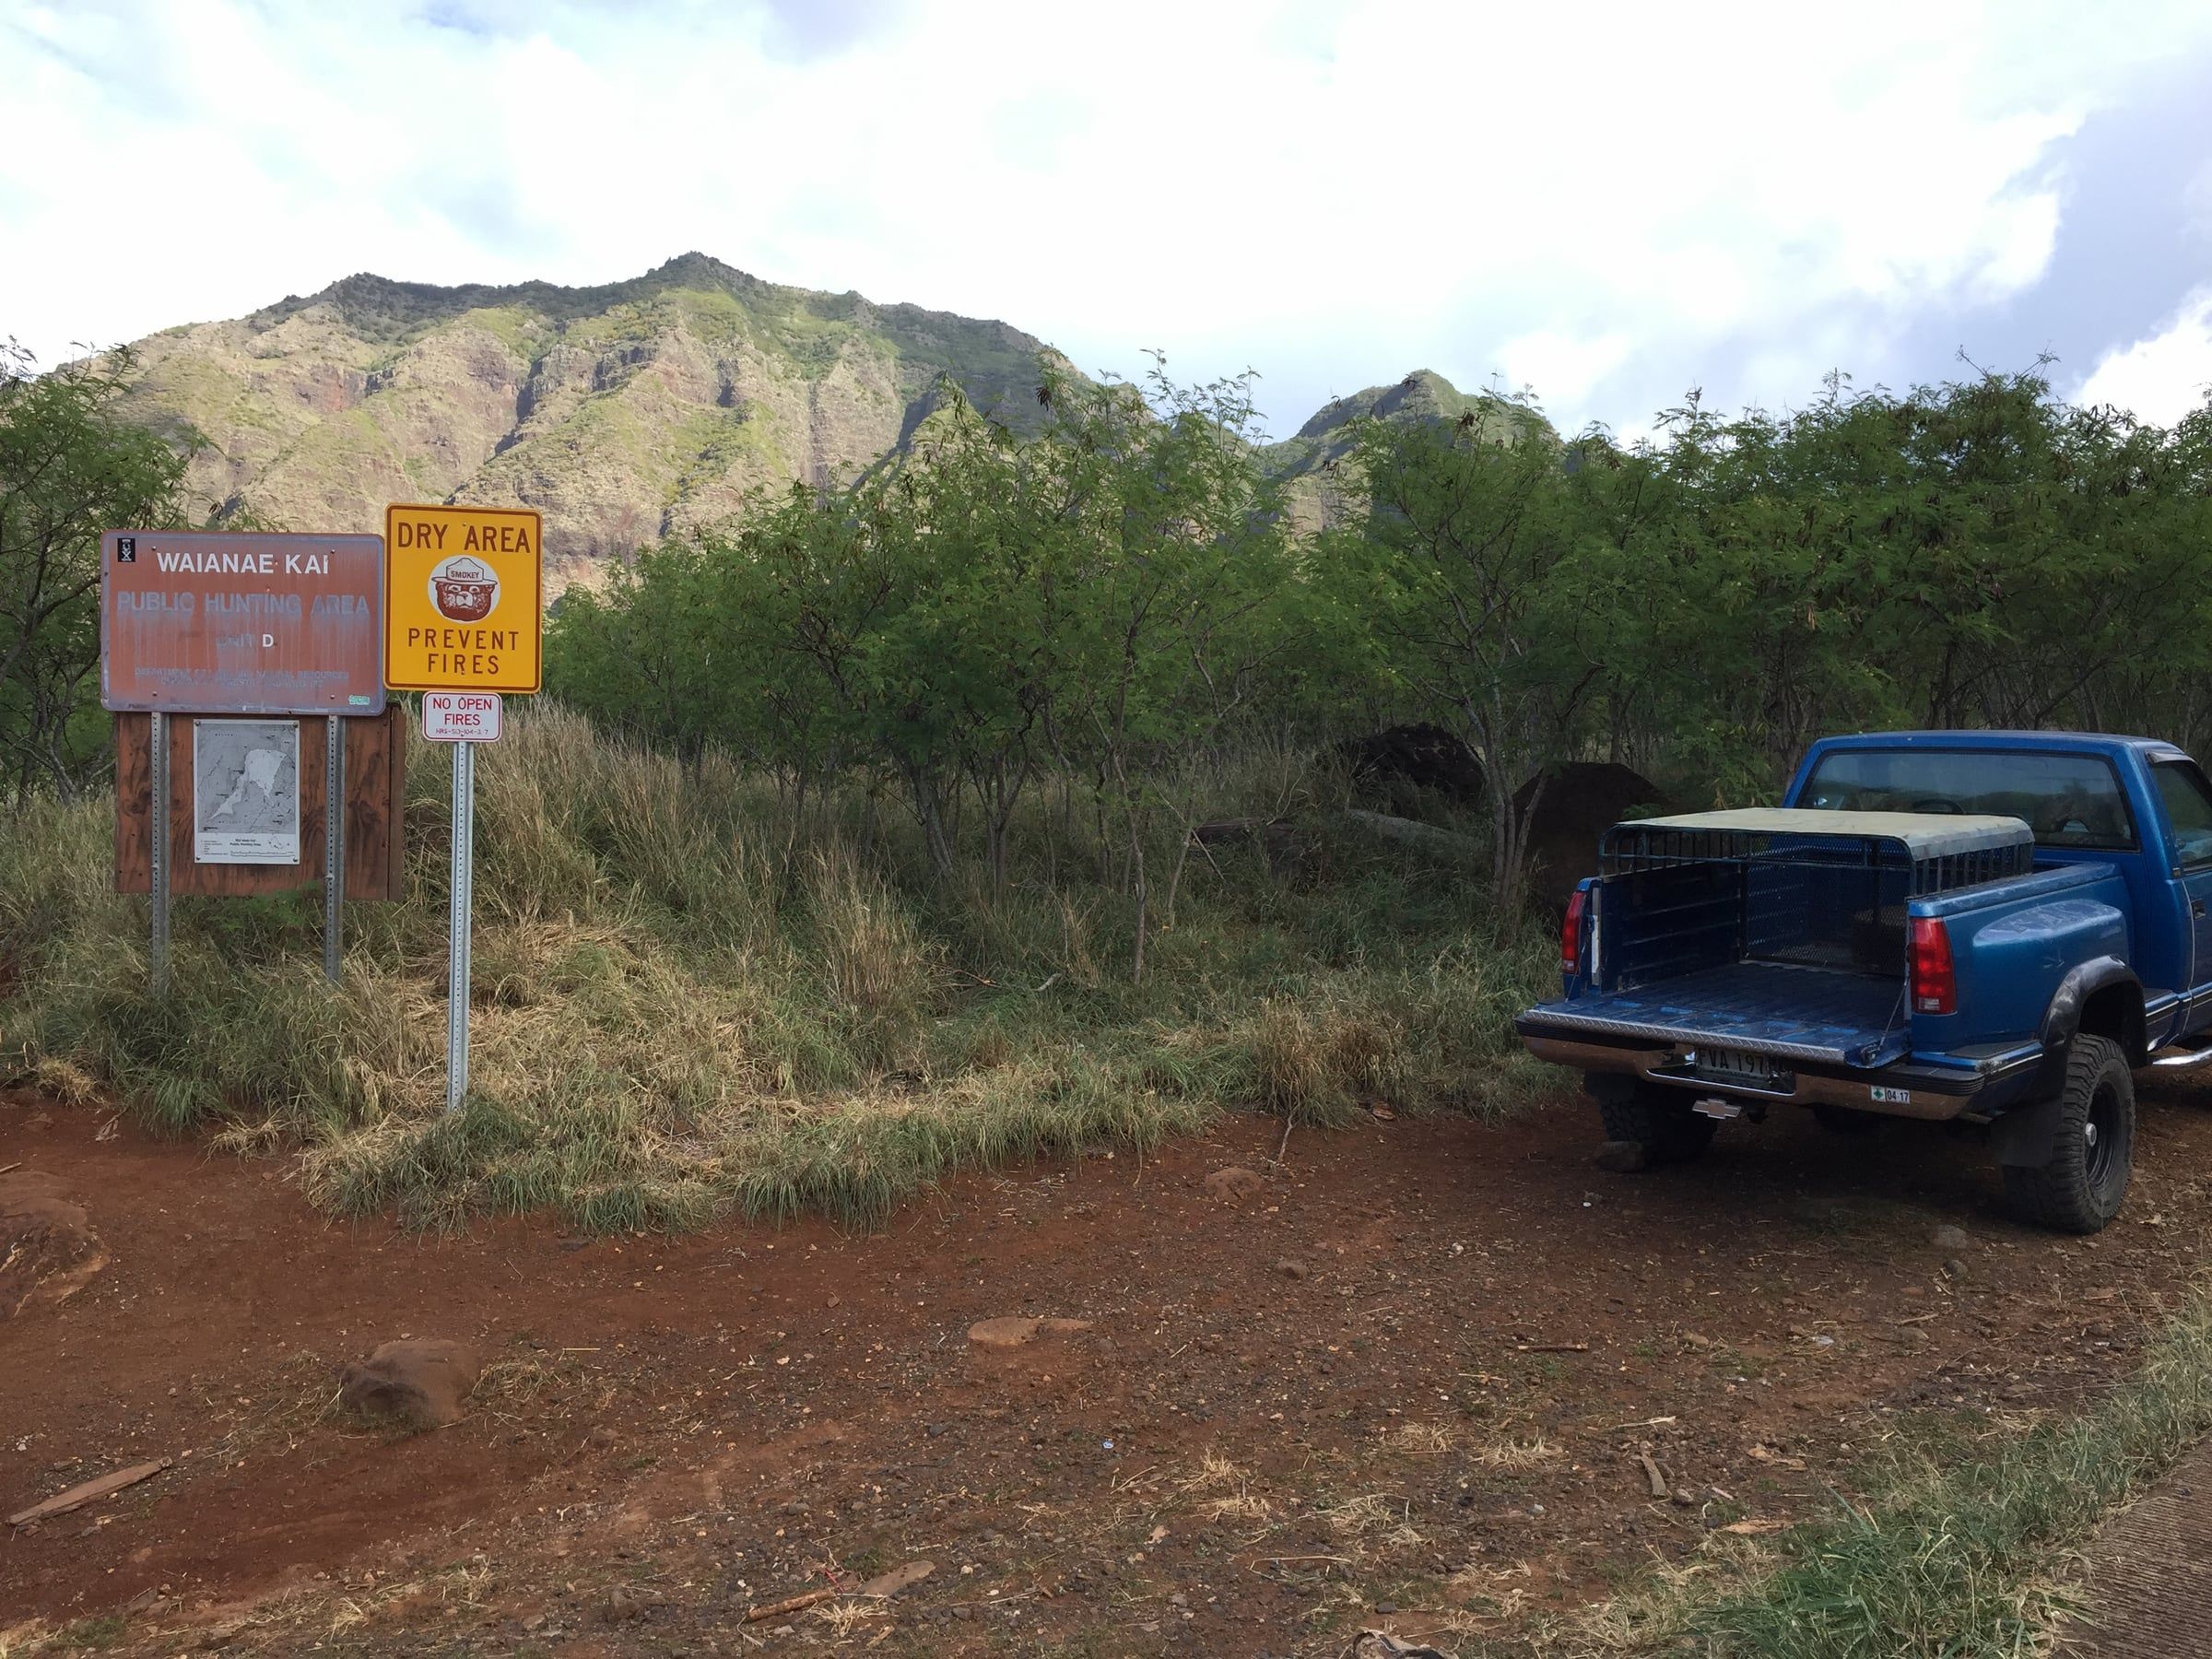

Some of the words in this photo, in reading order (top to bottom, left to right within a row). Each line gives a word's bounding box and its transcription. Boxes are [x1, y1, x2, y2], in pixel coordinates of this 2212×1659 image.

[397, 522, 449, 549] DRY
[464, 525, 531, 553] AREA
[157, 552, 274, 574] WAIANAE
[285, 553, 329, 575] KAI
[450, 570, 480, 579] SMOKEY
[117, 591, 194, 613] PUBLIC
[205, 593, 301, 615] HUNTING
[311, 594, 369, 615] AREA
[262, 633, 275, 648] D
[408, 628, 519, 651] PREVENT
[428, 653, 500, 675] FIRES
[432, 697, 451, 710] NO
[457, 697, 492, 711] OPEN
[444, 713, 481, 725] FIRES
[1887, 1089, 1897, 1100] 04
[1900, 1091, 1909, 1101] 17
